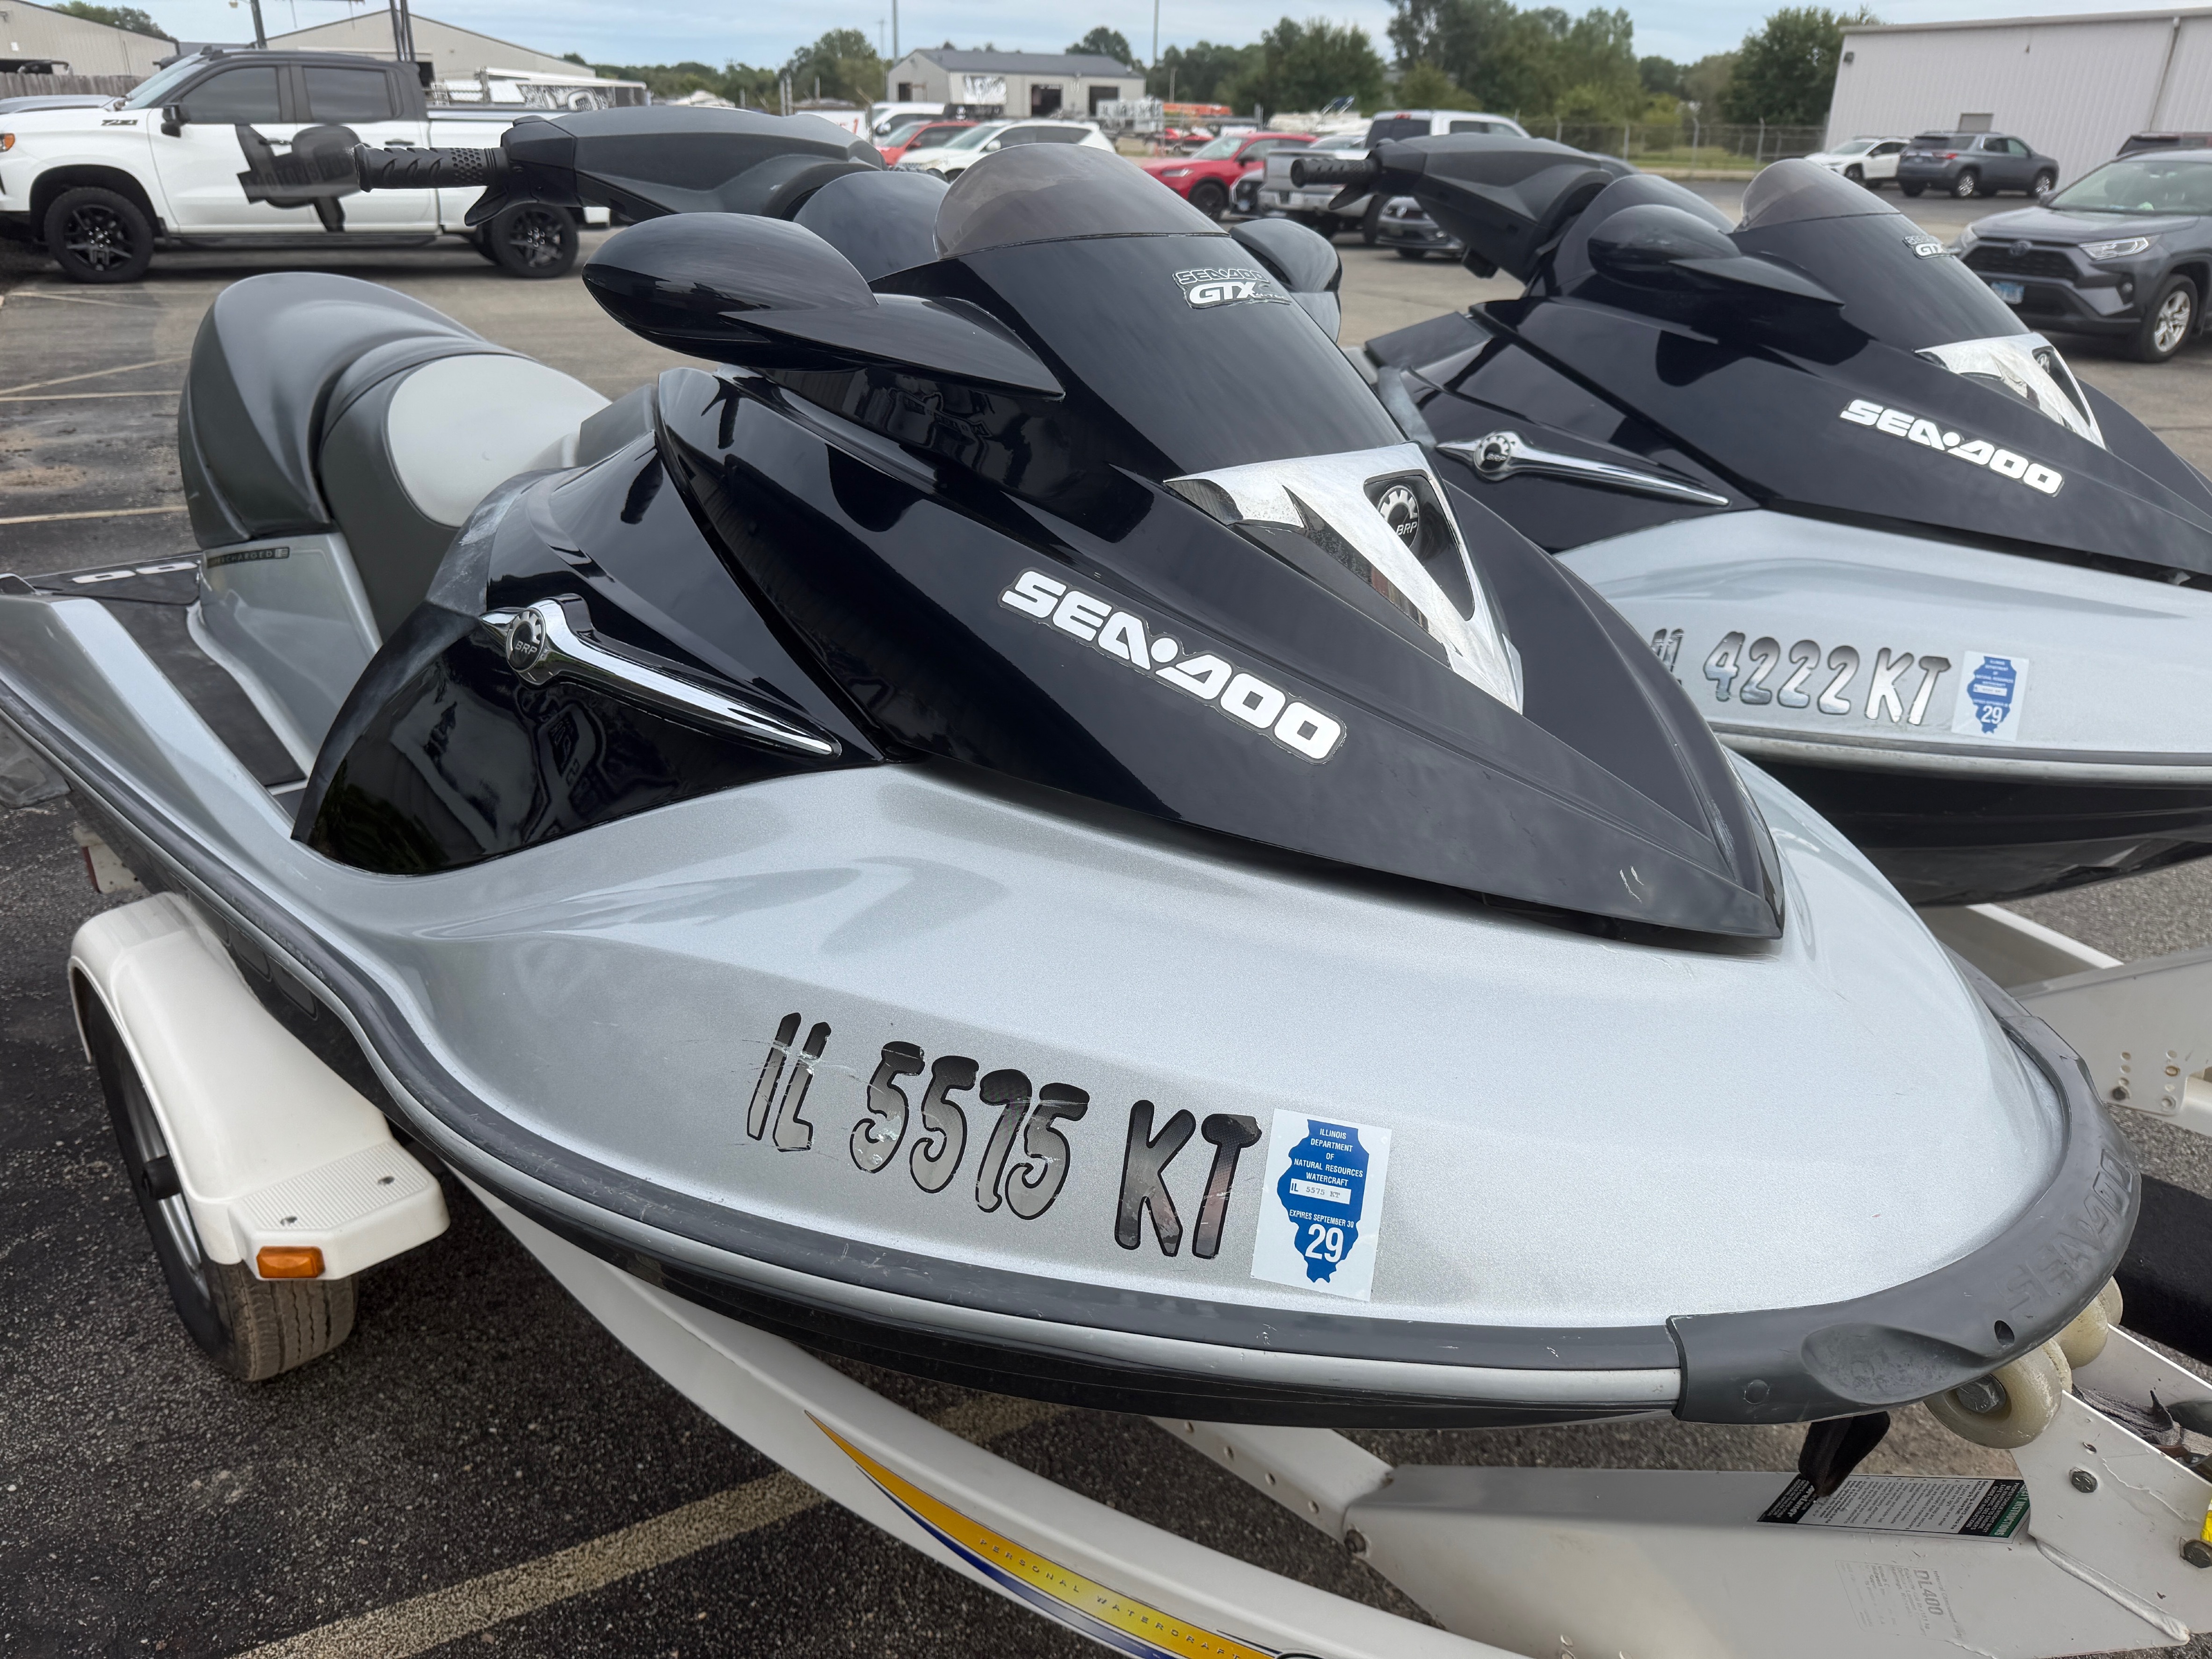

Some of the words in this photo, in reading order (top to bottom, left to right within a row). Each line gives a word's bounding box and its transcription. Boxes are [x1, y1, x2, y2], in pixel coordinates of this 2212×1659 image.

[1189, 281, 1258, 304] GTX
[1487, 452, 1507, 462] BRP
[1396, 521, 1417, 535] BRP
[515, 640, 538, 655] BRP
[1703, 631, 1860, 715] 4222
[1864, 647, 1951, 726] KT
[1981, 705, 2003, 725] 29
[747, 1012, 832, 1152] IL
[849, 1040, 1090, 1221] 5575
[1114, 1099, 1262, 1259] KT
[1319, 1128, 1347, 1140] ILLINOIS
[1310, 1138, 1353, 1152] DEPARTMENT
[1294, 1158, 1323, 1170] NATURAL
[1325, 1164, 1363, 1178] RESOURCES
[1306, 1171, 1349, 1186] WATERCRAFT
[1291, 1182, 1298, 1192] IL
[1305, 1186, 1325, 1196] 5575
[1289, 1209, 1312, 1220] EXPIRES
[1313, 1214, 1346, 1227] SEPTEMBER
[1305, 1223, 1344, 1262] 29
[1993, 1501, 2026, 1535] INSTRUCTIONS
[979, 1538, 1080, 1593] PERSONAL
[1096, 1595, 1240, 1659] WATERCRAFT
[1913, 1569, 1944, 1615] DL400
